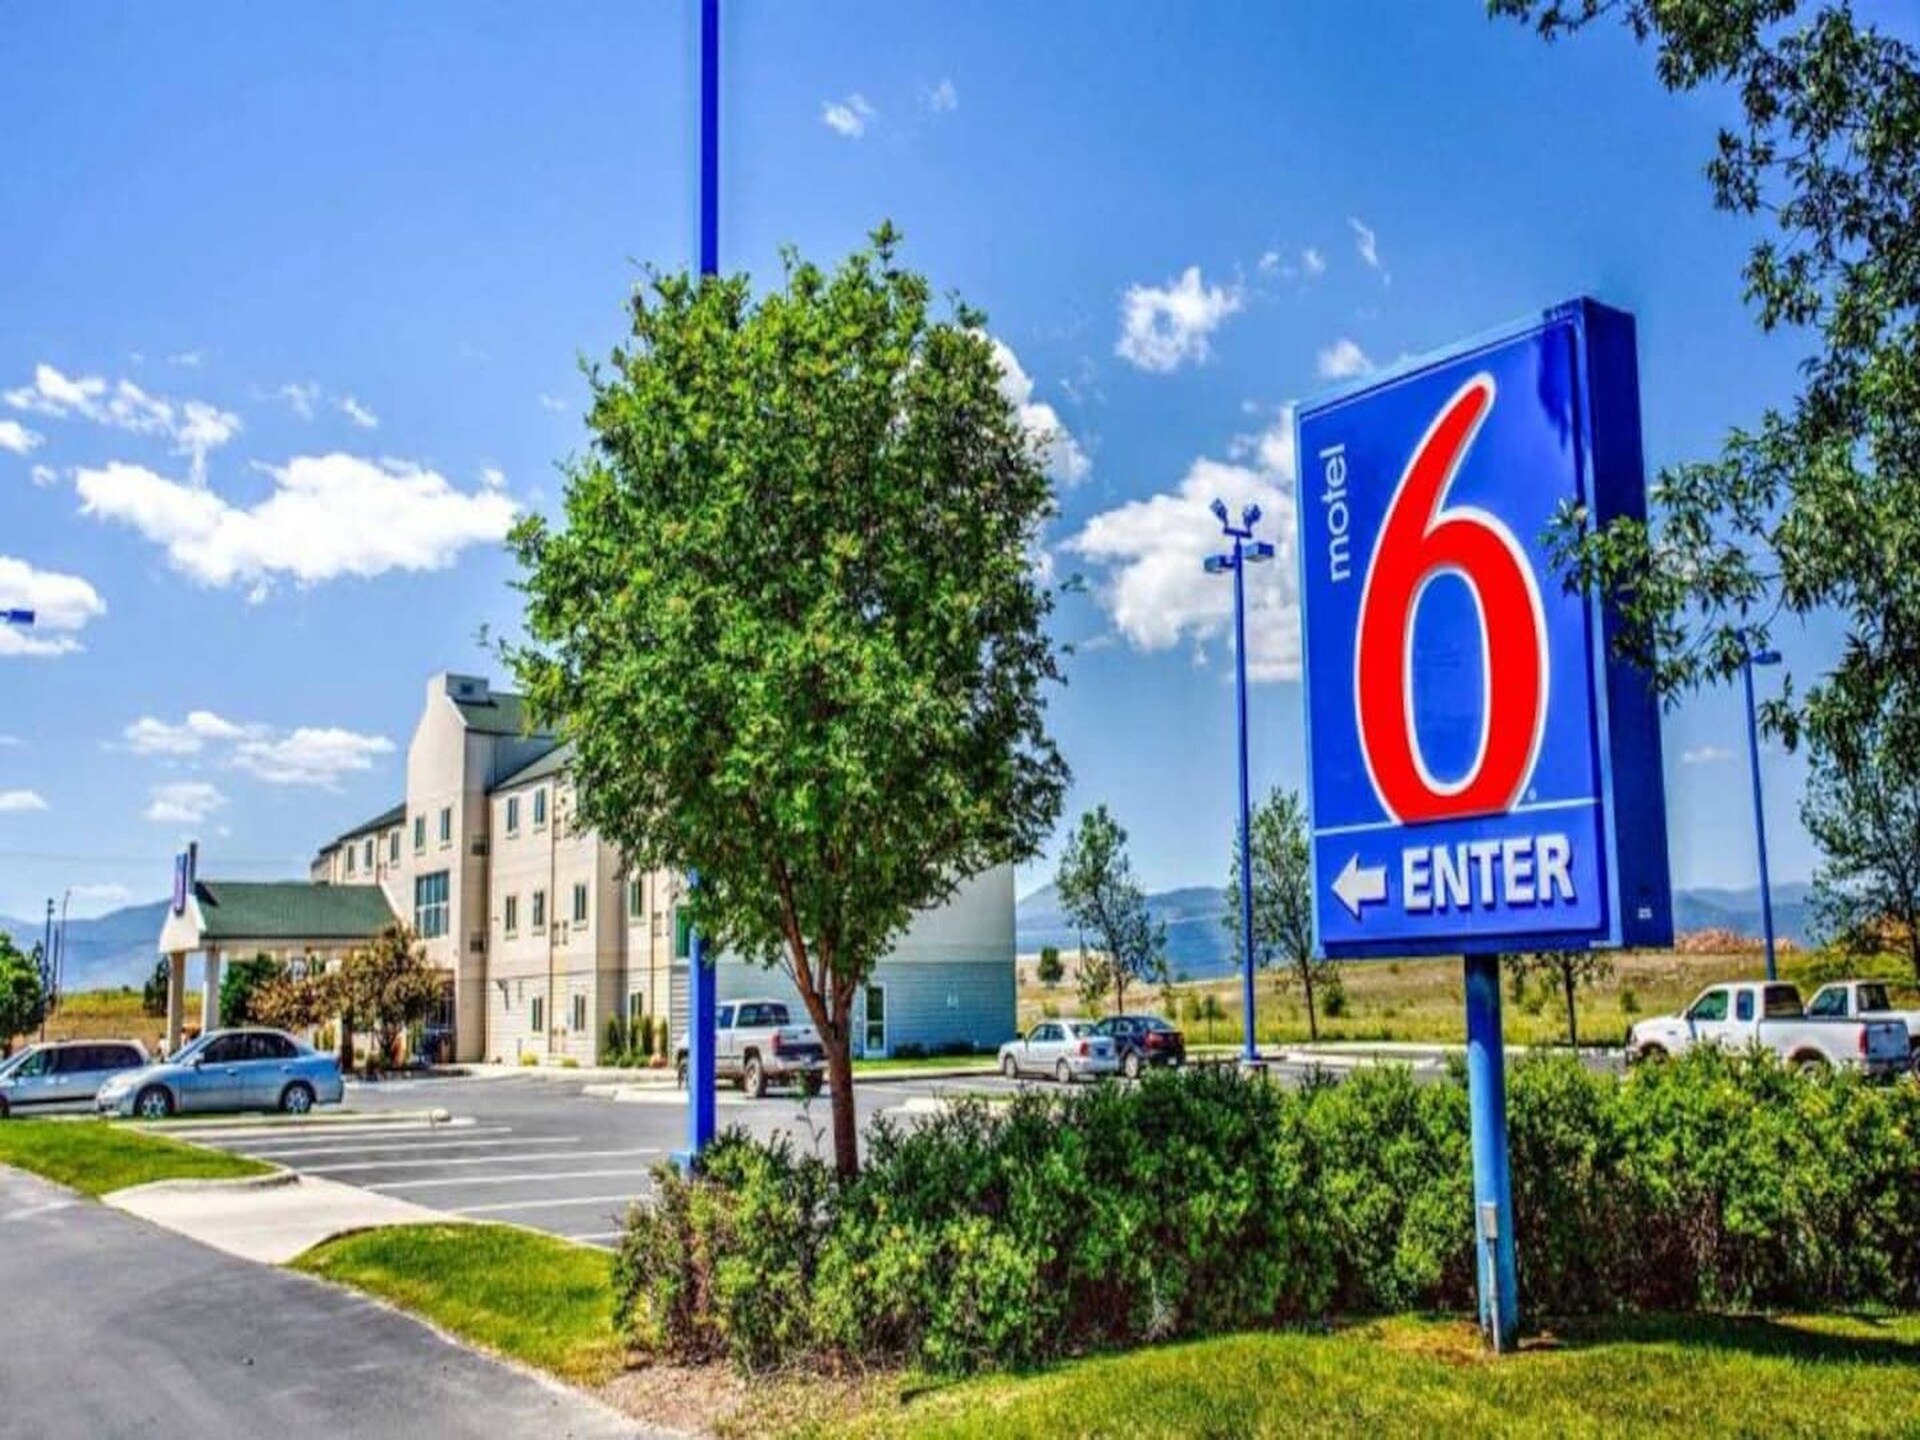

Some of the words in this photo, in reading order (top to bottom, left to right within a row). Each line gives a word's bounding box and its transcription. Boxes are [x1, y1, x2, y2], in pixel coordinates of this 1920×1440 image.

[1319, 443, 1350, 583] motel
[1353, 372, 1549, 826] 6
[1402, 833, 1575, 910] ENTER
